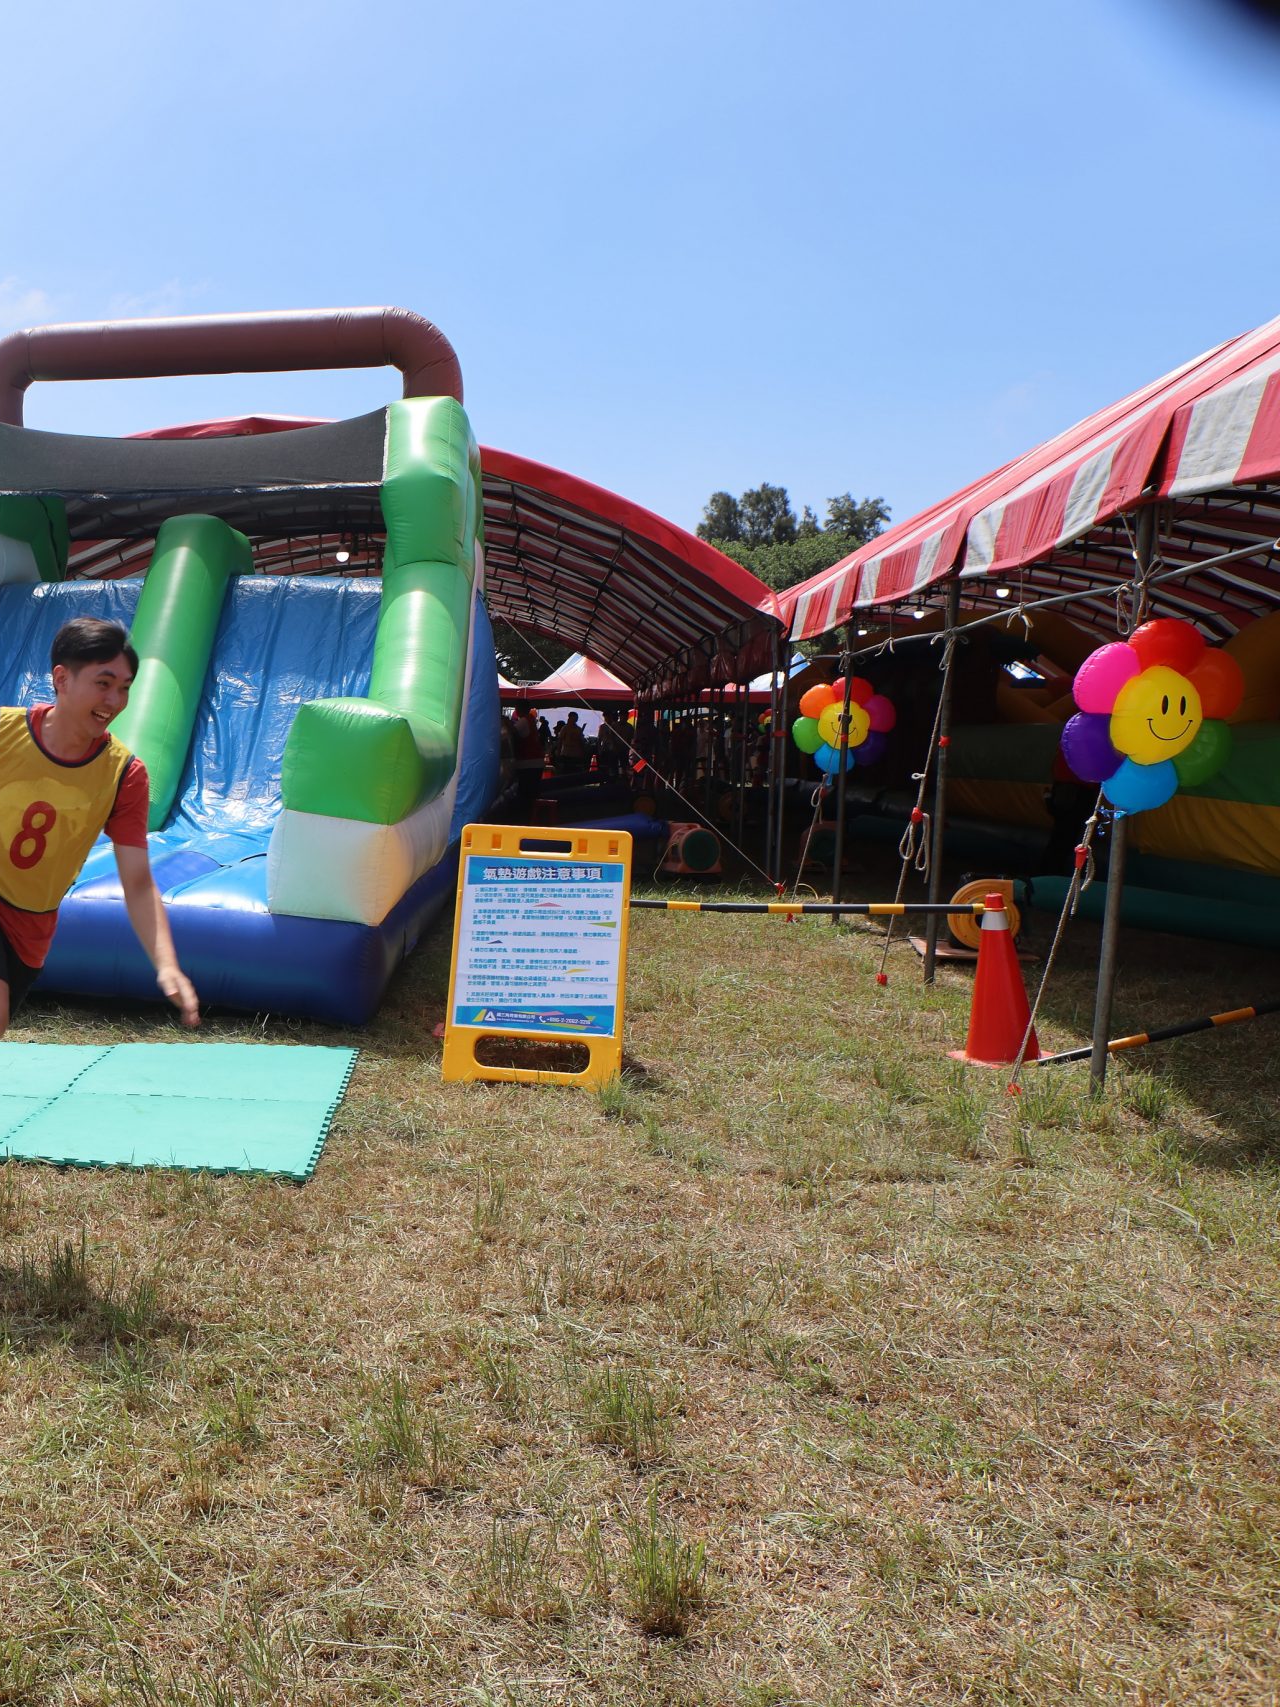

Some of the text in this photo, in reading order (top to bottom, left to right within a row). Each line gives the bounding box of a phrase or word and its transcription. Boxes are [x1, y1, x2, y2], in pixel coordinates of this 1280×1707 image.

[9, 800, 57, 870] 8
[483, 867, 602, 880] 氣墊遊戲注意事項
